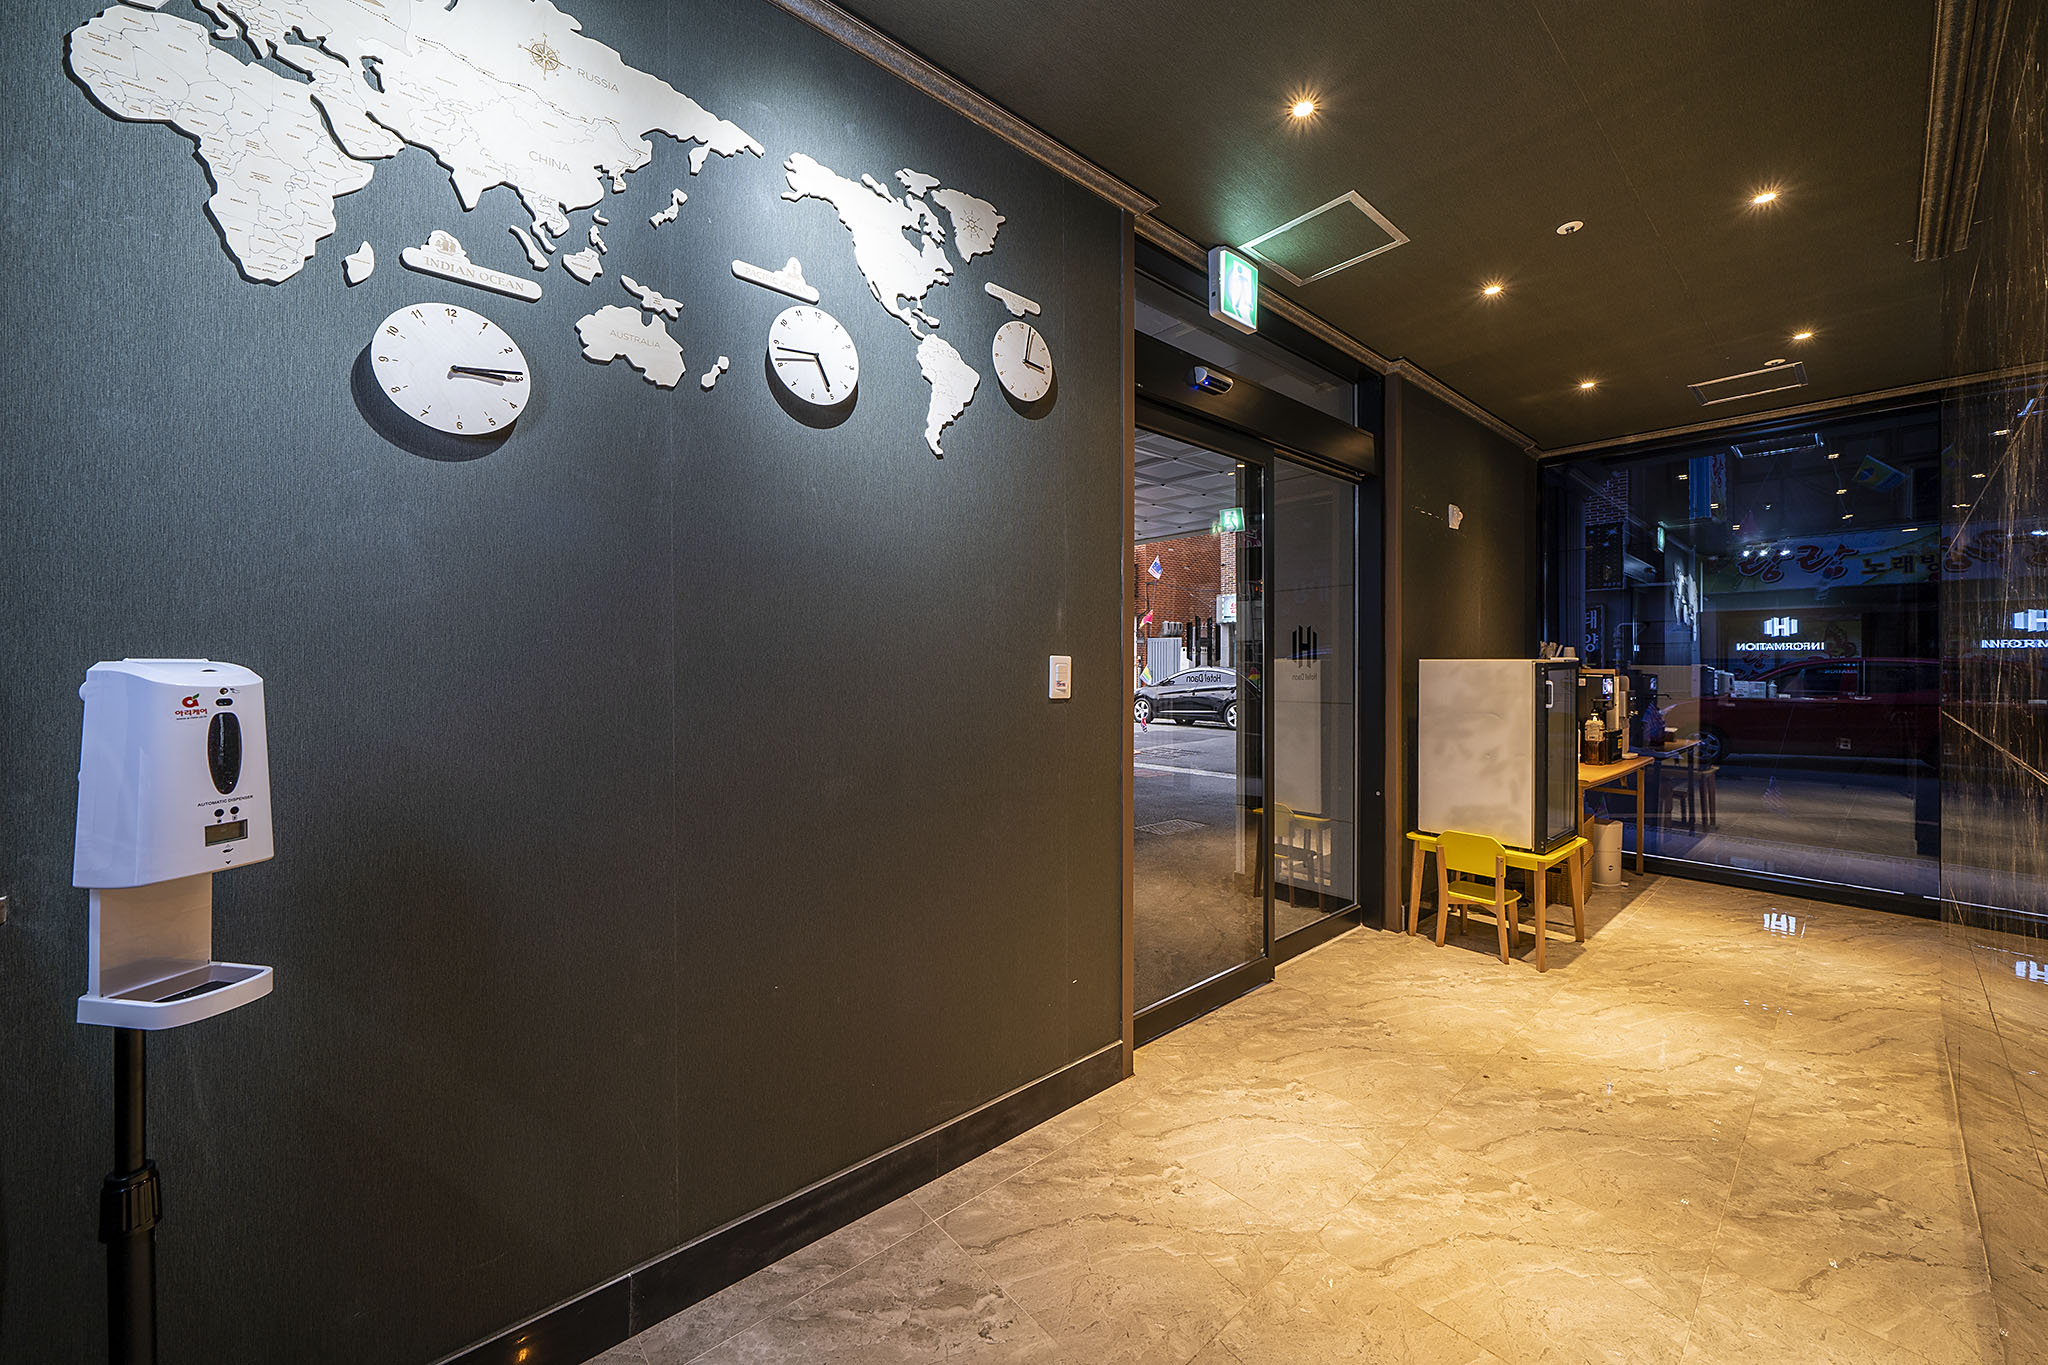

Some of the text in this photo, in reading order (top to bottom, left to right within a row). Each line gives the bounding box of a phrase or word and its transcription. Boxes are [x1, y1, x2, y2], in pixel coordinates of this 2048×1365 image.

[577, 67, 620, 94] RUSSIA
[528, 150, 571, 174] CHINA
[465, 167, 487, 178] INDIA
[424, 255, 525, 292] INDIAN OCEAN
[410, 309, 424, 320] 11
[444, 308, 458, 318] 12
[481, 321, 489, 330] 1
[386, 325, 399, 337] 10
[609, 329, 661, 350] AUSTRALIA
[503, 346, 513, 354] 2
[378, 355, 389, 363] 9
[390, 386, 401, 394] 8
[508, 402, 518, 410] 4
[420, 409, 429, 418] 7
[456, 421, 463, 430] 6
[487, 417, 497, 427] 5
[197, 794, 253, 807] AUTOMATIC DISPENSER
